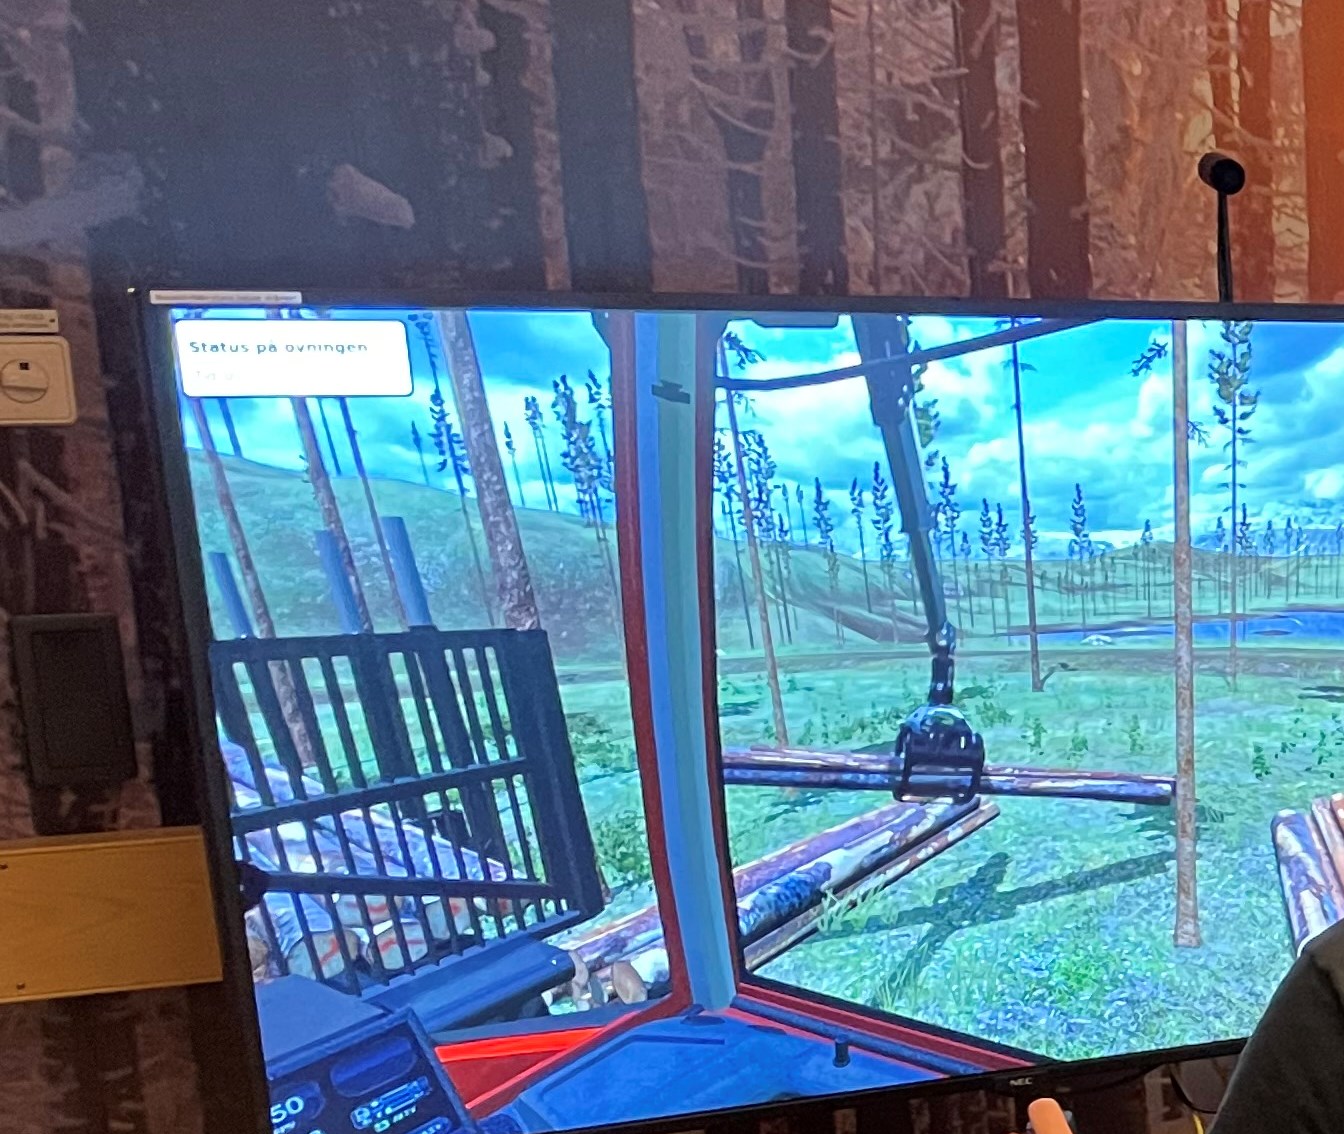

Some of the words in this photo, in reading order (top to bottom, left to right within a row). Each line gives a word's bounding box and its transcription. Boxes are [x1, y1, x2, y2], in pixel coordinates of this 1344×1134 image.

[189, 341, 250, 353] Status
[256, 338, 278, 355] på
[270, 1096, 304, 1123] 50
